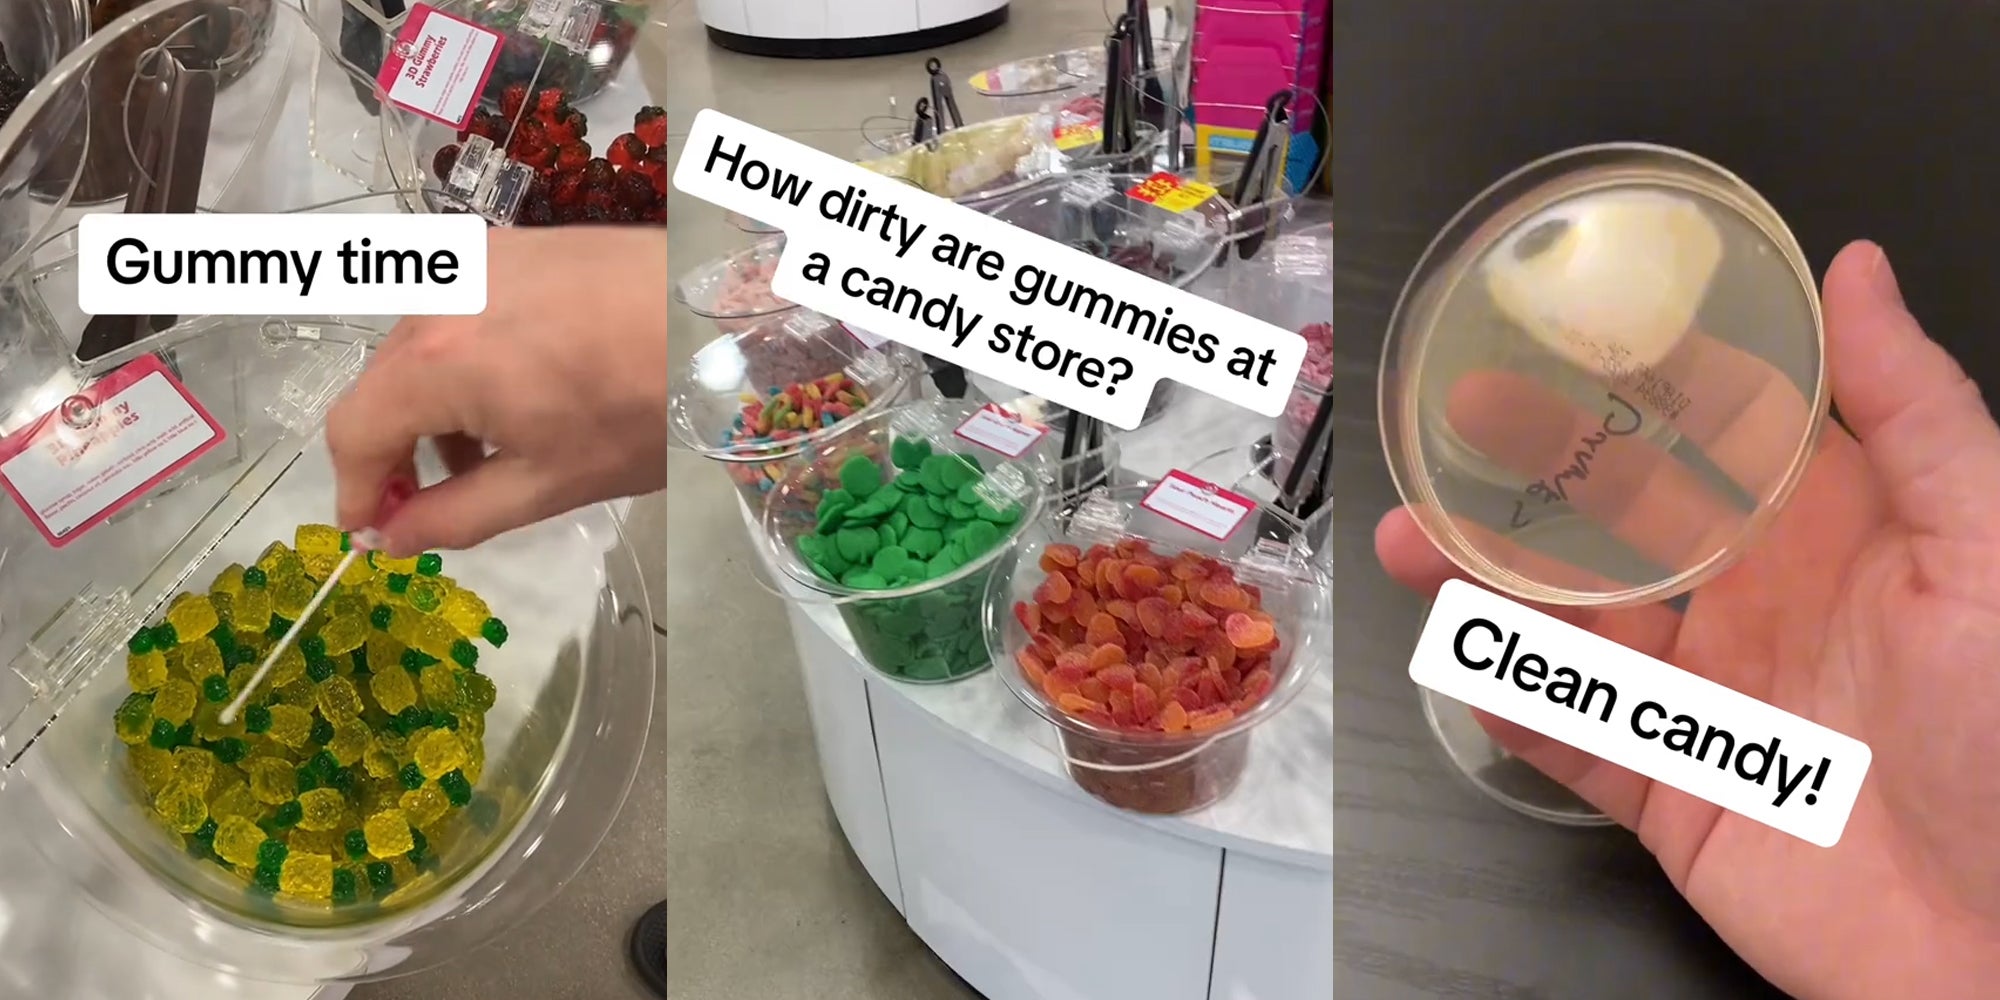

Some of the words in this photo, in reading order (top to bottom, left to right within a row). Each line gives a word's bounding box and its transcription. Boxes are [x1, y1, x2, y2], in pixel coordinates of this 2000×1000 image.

[405, 66, 418, 80] 3D
[412, 34, 436, 66] Gummy
[415, 36, 448, 88] Strawberries
